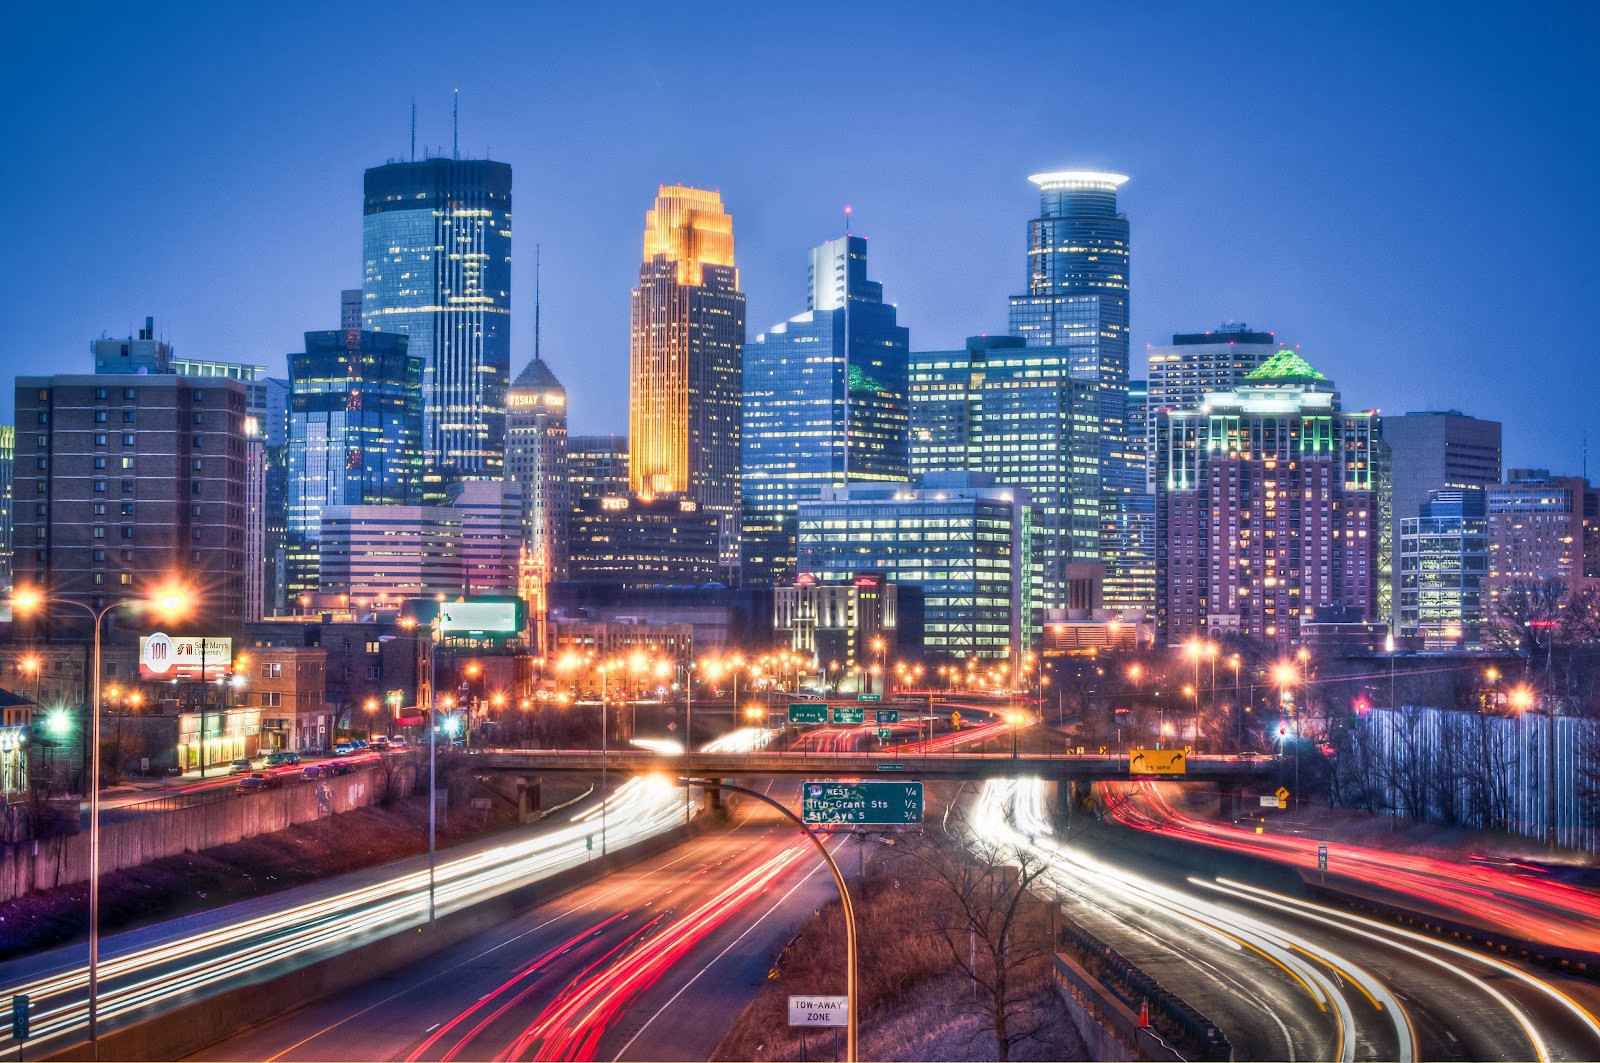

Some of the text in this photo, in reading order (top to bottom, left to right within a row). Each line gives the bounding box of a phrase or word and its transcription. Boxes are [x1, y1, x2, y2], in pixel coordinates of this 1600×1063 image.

[510, 395, 538, 405] FOSHAY
[151, 642, 167, 660] 100
[826, 788, 849, 796] WEST
[809, 799, 917, 809] 11th-Grant Sts 1/2
[809, 811, 828, 820] 5th
[834, 811, 854, 821] Ave
[858, 811, 866, 820] S
[795, 1001, 843, 1009] TOW-AWAY
[807, 1012, 831, 1021] ZONE
